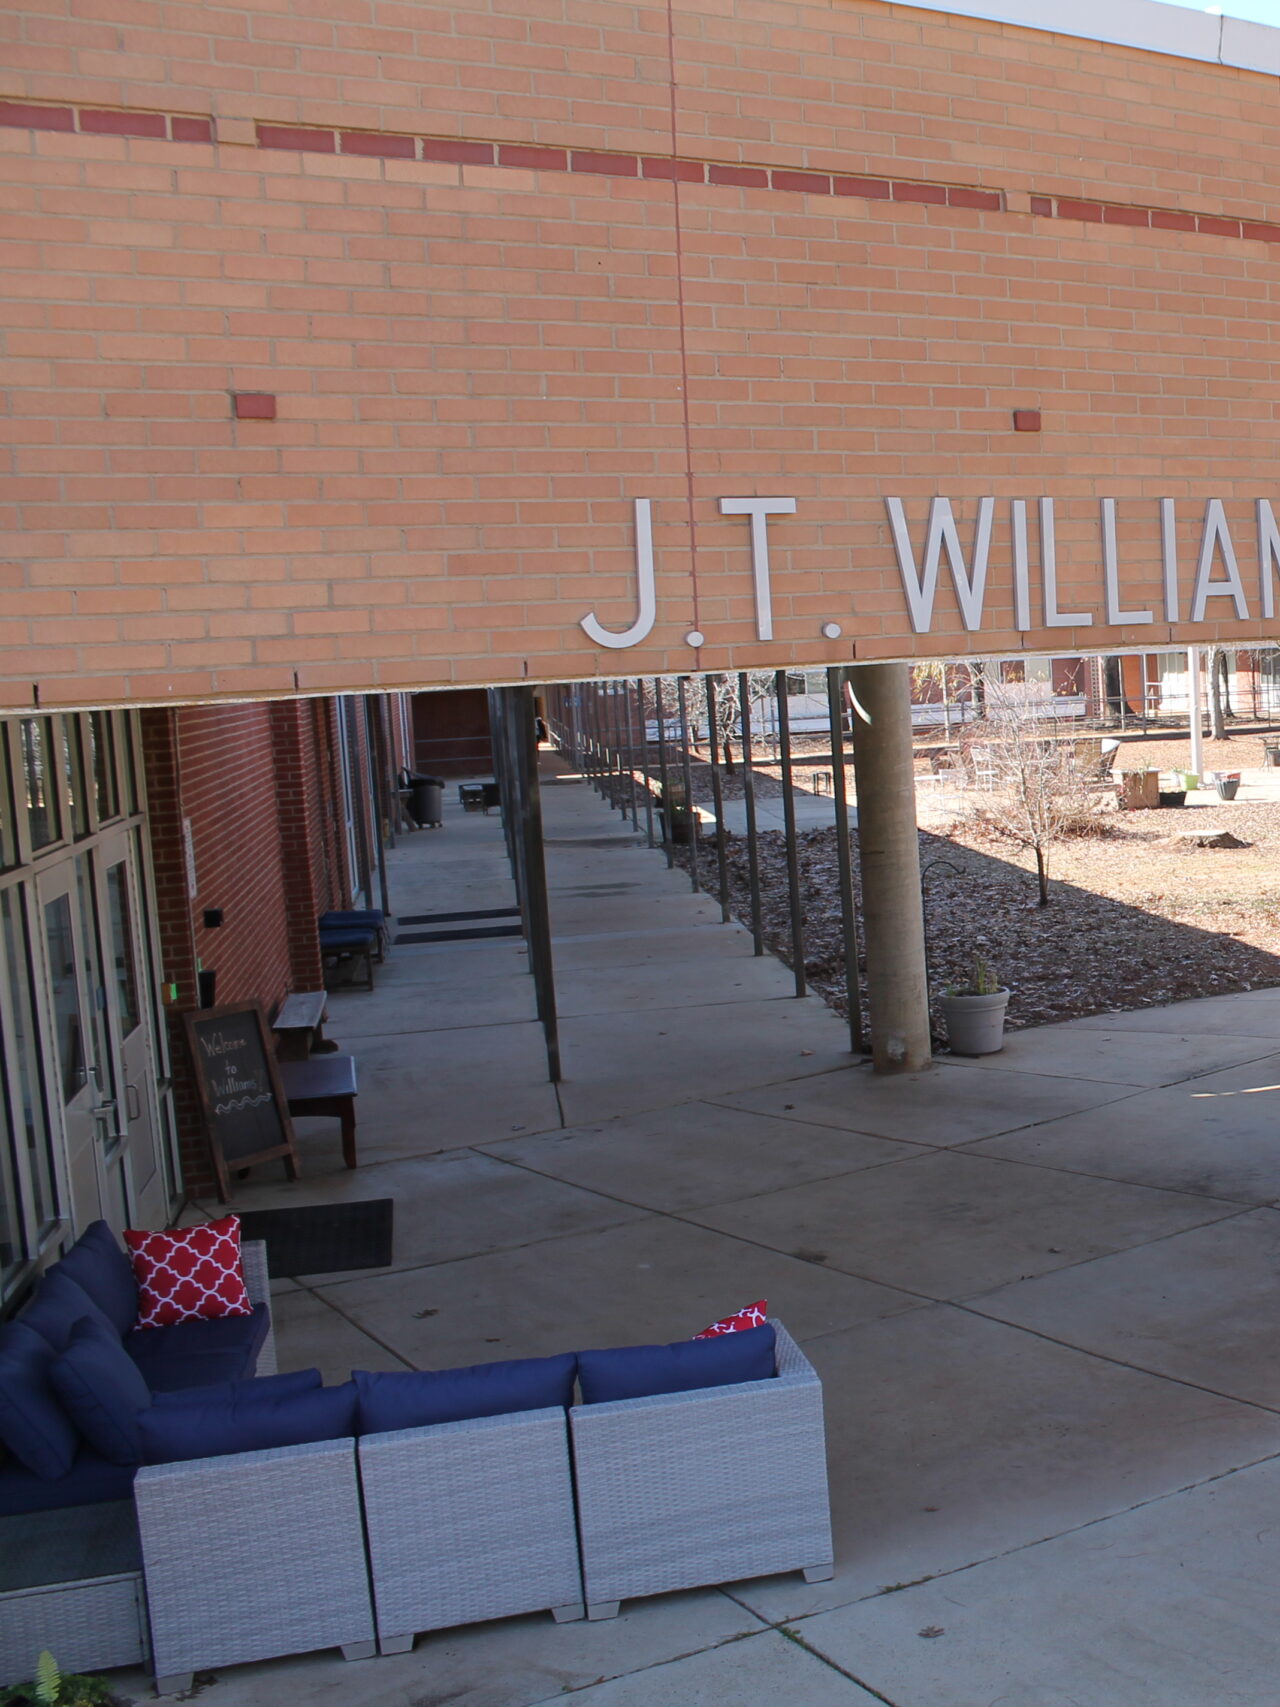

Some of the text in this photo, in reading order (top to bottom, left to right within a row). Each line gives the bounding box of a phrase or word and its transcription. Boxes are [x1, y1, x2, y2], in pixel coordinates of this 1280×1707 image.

[579, 497, 843, 650] J.T.
[201, 1032, 247, 1056] Welcome
[225, 1060, 237, 1074] to
